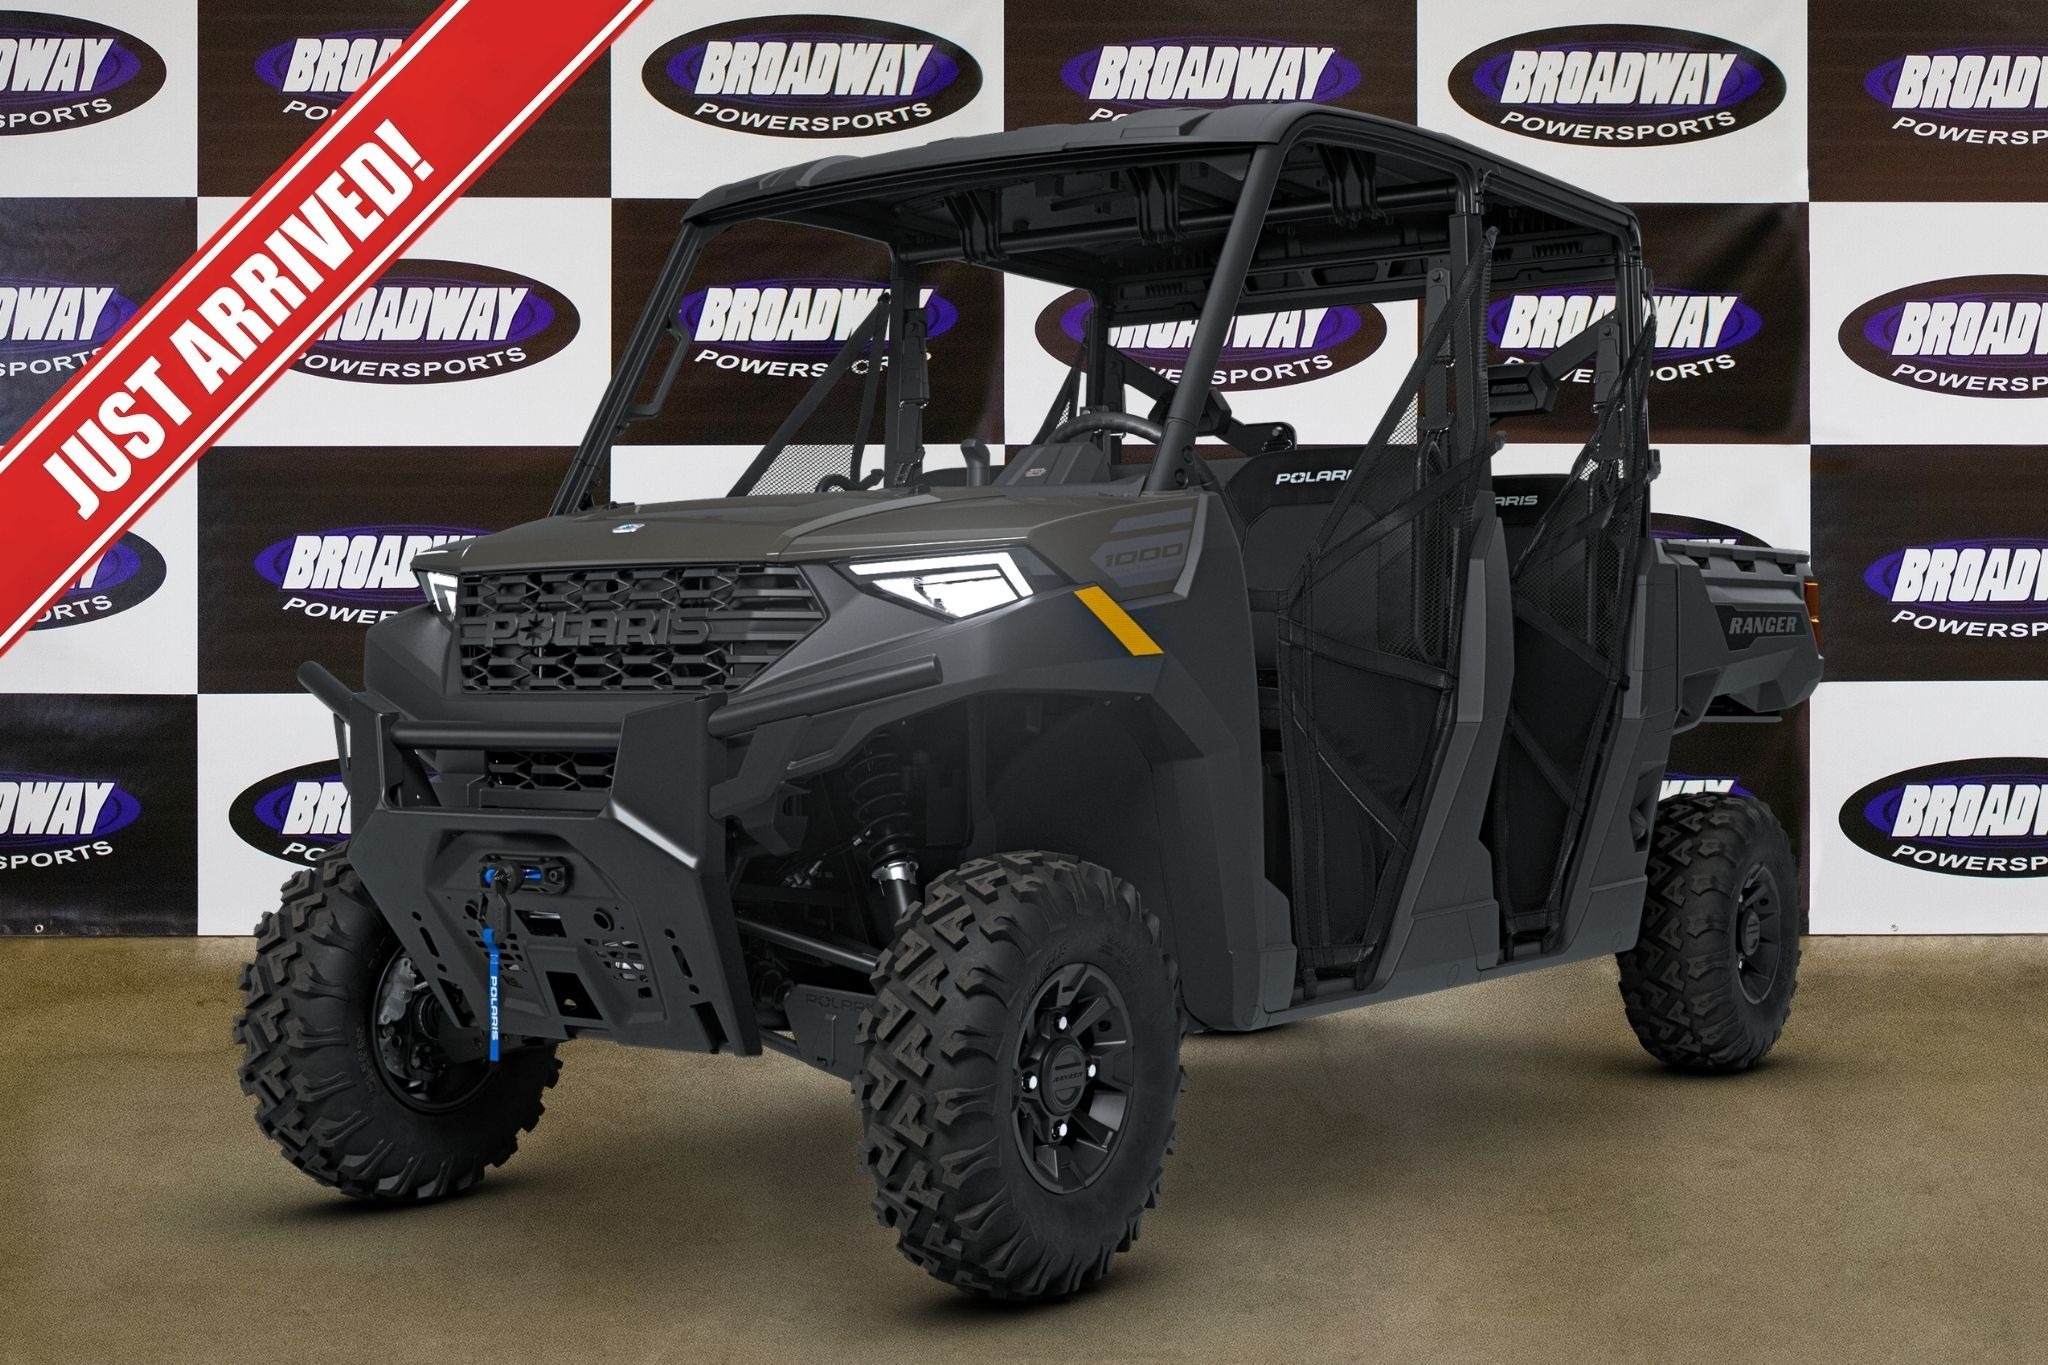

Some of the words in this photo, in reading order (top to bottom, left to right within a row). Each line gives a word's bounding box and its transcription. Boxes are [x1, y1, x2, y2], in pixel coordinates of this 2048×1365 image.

[694, 41, 934, 96] BROADWAY
[1088, 46, 1336, 100] BROADWAY
[1500, 50, 1738, 105] BROADWAY
[1891, 55, 2048, 109] BROAD
[694, 102, 933, 132] POWERSPORTS
[1500, 111, 1737, 140] POWERSPORTS
[320, 286, 529, 341] OADWAY
[1500, 295, 1738, 349] BROWAY
[1891, 301, 2048, 356] BROAD
[281, 534, 477, 590] BROAD
[1104, 542, 1184, 568] 1000
[1891, 548, 2048, 602] BROAD
[484, 607, 712, 647] POLARIS
[1728, 616, 1798, 635] RANGER
[1891, 784, 2048, 837] BROAD
[490, 975, 499, 1041] POLARIS
